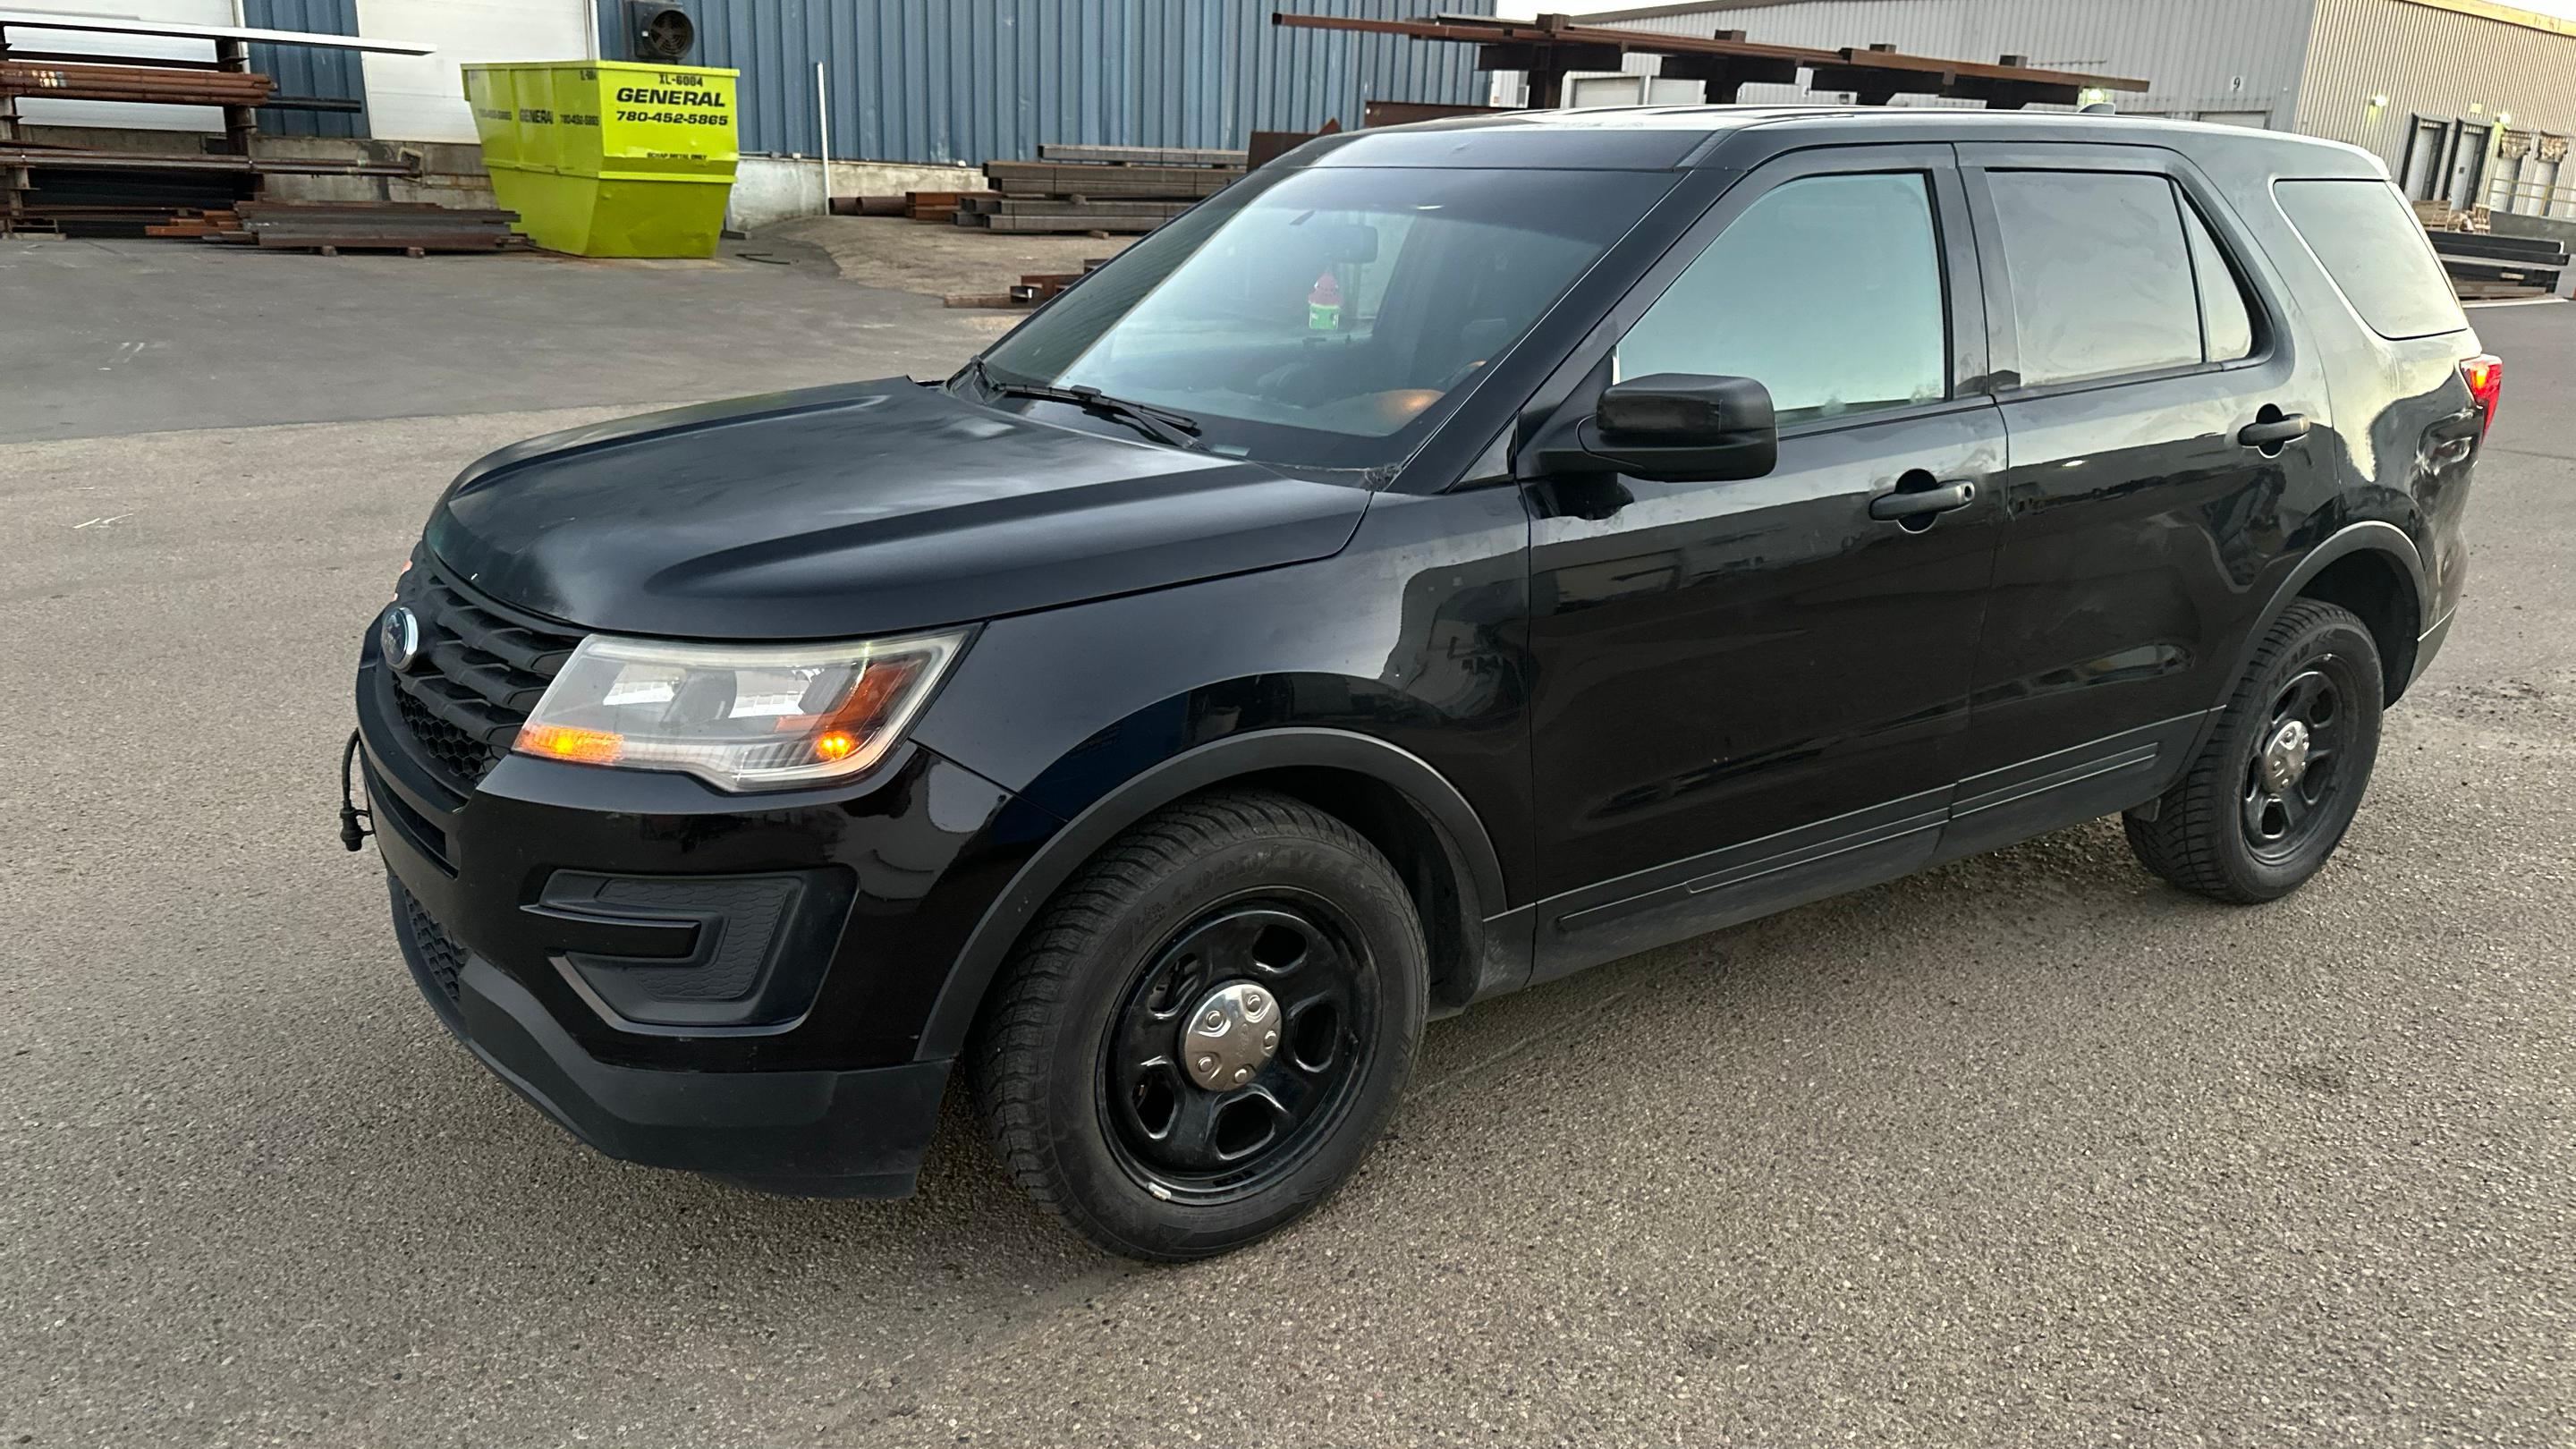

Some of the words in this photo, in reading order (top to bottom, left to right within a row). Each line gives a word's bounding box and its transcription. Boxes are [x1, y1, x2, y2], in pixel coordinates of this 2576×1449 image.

[2233, 77, 2241, 90] 9
[616, 88, 725, 107] GENERAL
[520, 108, 554, 124] GENERA
[616, 111, 728, 126] 780-452-5865
